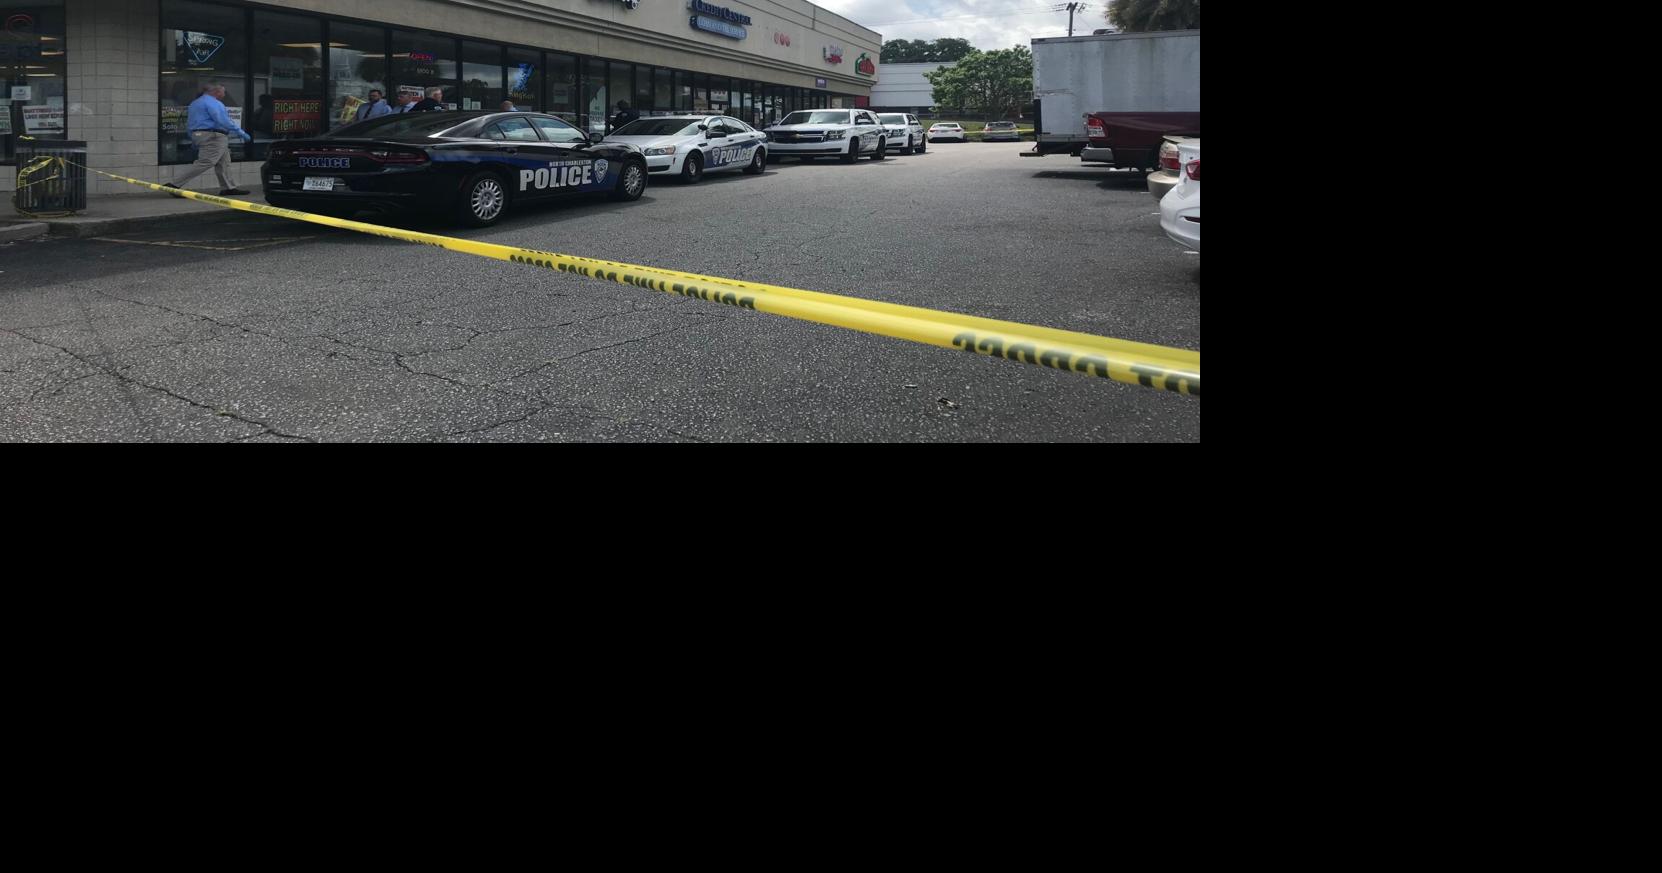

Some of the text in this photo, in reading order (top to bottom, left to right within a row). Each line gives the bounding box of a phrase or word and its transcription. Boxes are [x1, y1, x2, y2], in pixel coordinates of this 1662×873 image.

[274, 103, 321, 113] RIGHT HERE
[274, 120, 299, 131] RIGHT
[719, 148, 754, 164] POLICE
[298, 157, 351, 168] POLICE
[519, 165, 593, 191] POLICE
